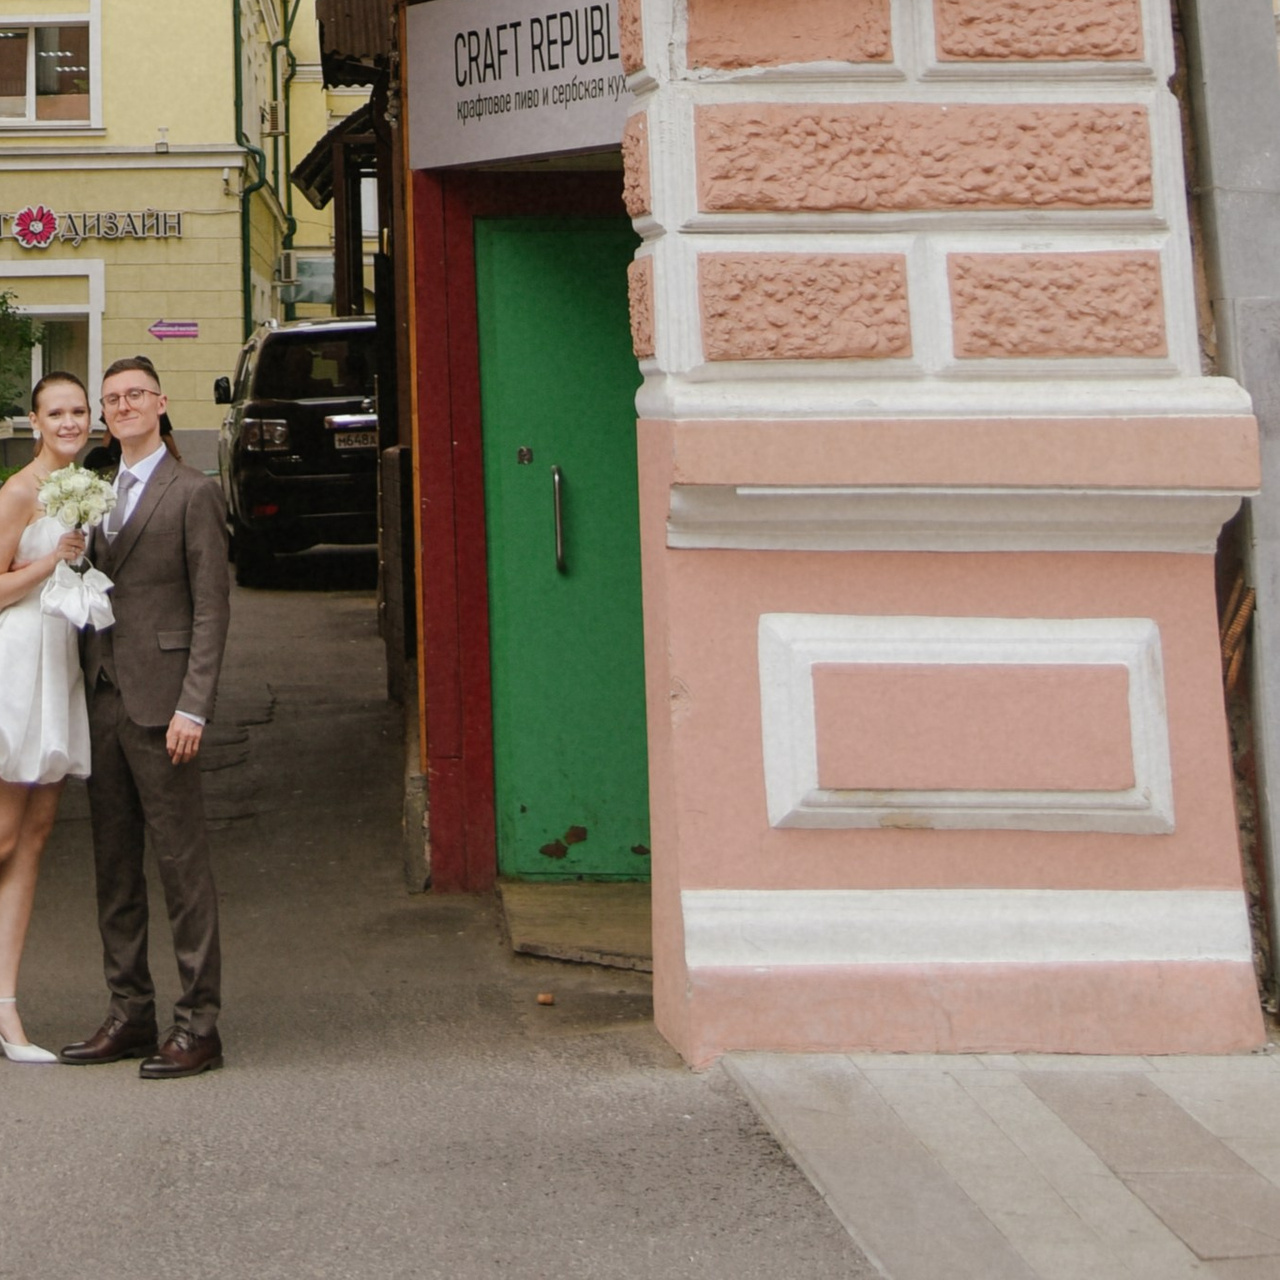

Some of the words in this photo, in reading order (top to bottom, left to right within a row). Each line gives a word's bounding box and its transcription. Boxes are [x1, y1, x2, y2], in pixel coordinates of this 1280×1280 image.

[454, 20, 521, 87] CRAFT
[530, 2, 619, 74] REPUBL
[457, 93, 511, 125] крафтовое
[515, 86, 539, 111] пиво
[542, 85, 549, 104] и
[552, 75, 604, 109] сербская
[607, 74, 631, 102] кух
[60, 208, 182, 246] ДИЗАЙН
